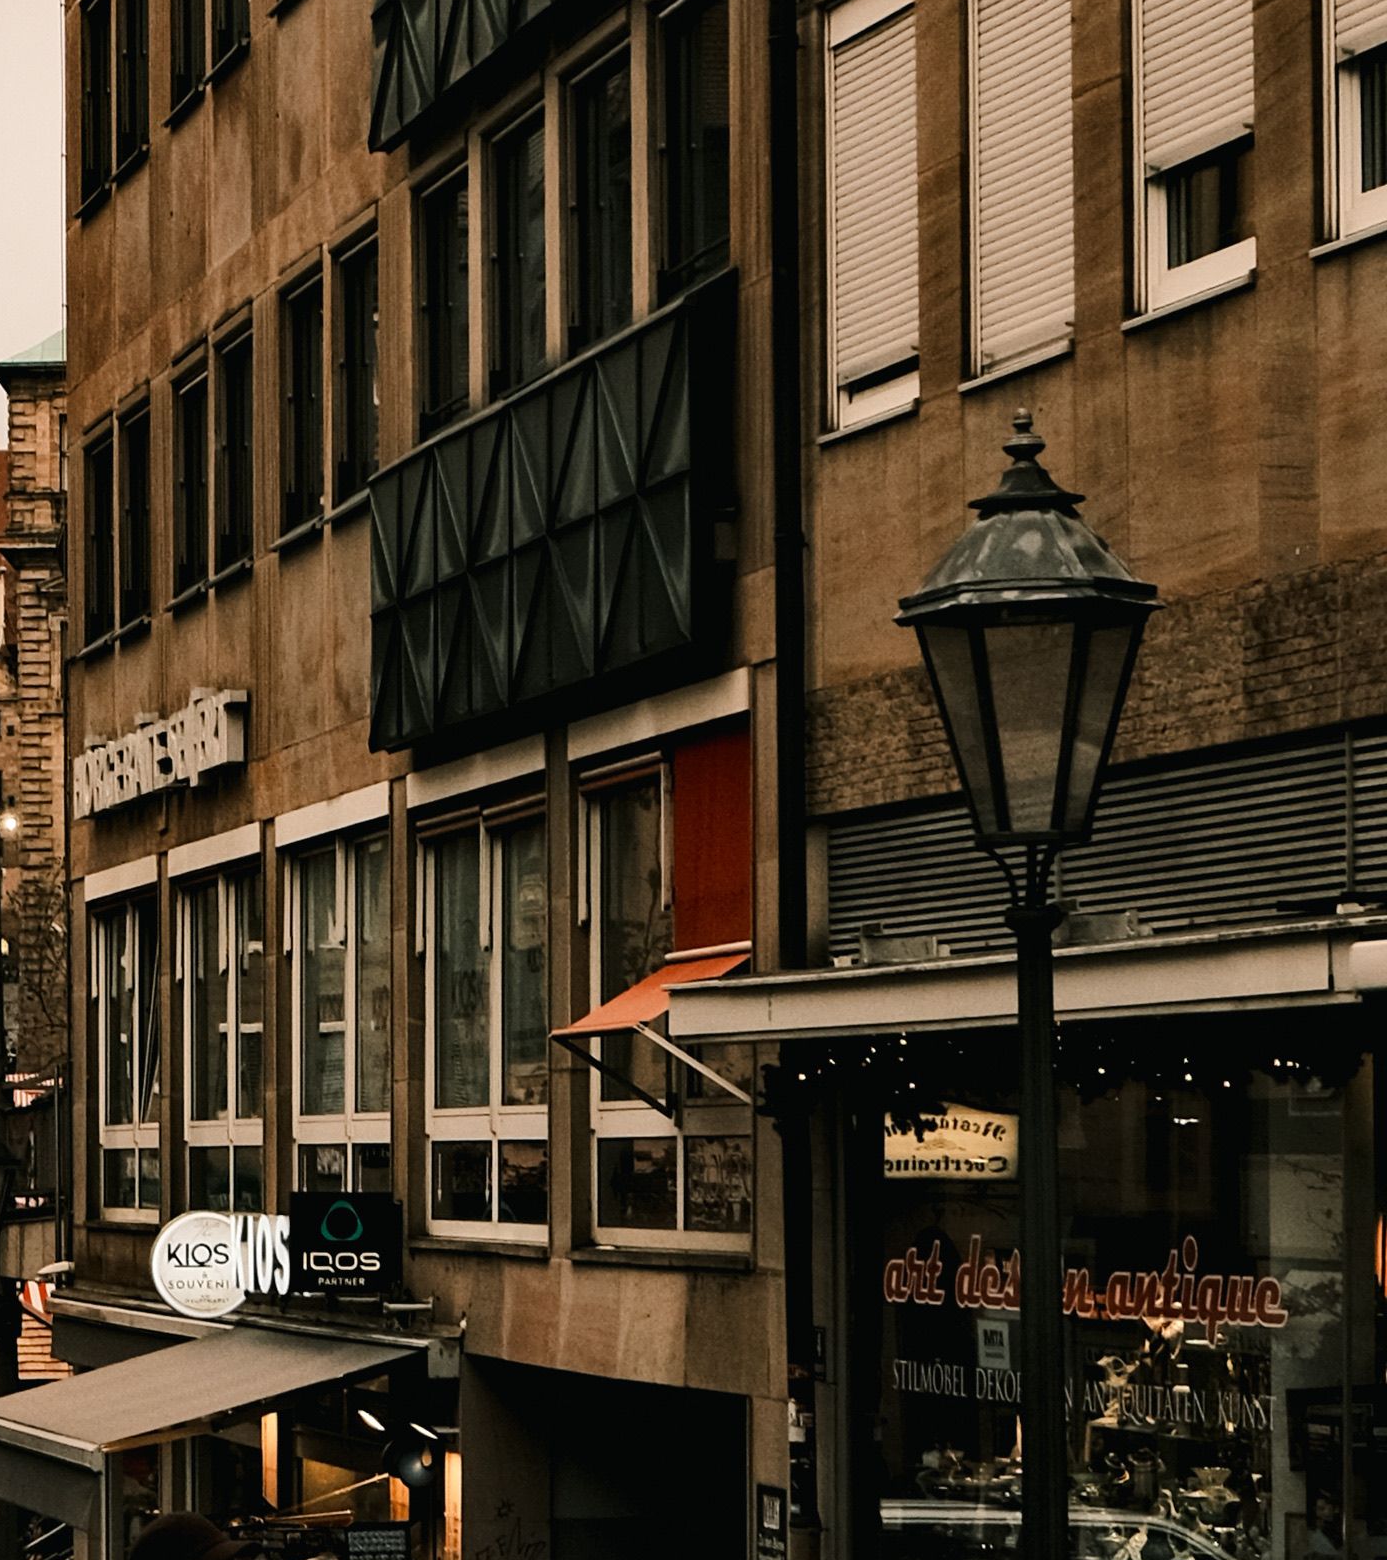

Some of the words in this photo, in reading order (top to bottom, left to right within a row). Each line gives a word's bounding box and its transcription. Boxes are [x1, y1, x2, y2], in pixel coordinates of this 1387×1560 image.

[168, 1243, 229, 1267] KIOS
[230, 1214, 290, 1296] KIOS
[303, 1251, 381, 1273] IQOS
[168, 1280, 230, 1290] SOUVENI
[318, 1277, 366, 1287] PARTNER
[884, 1239, 946, 1306] art
[955, 1234, 1095, 1318] desn
[1106, 1234, 1289, 1349] antique
[892, 1357, 968, 1398] STILMÖBEL
[1217, 1390, 1277, 1431] KUNST
